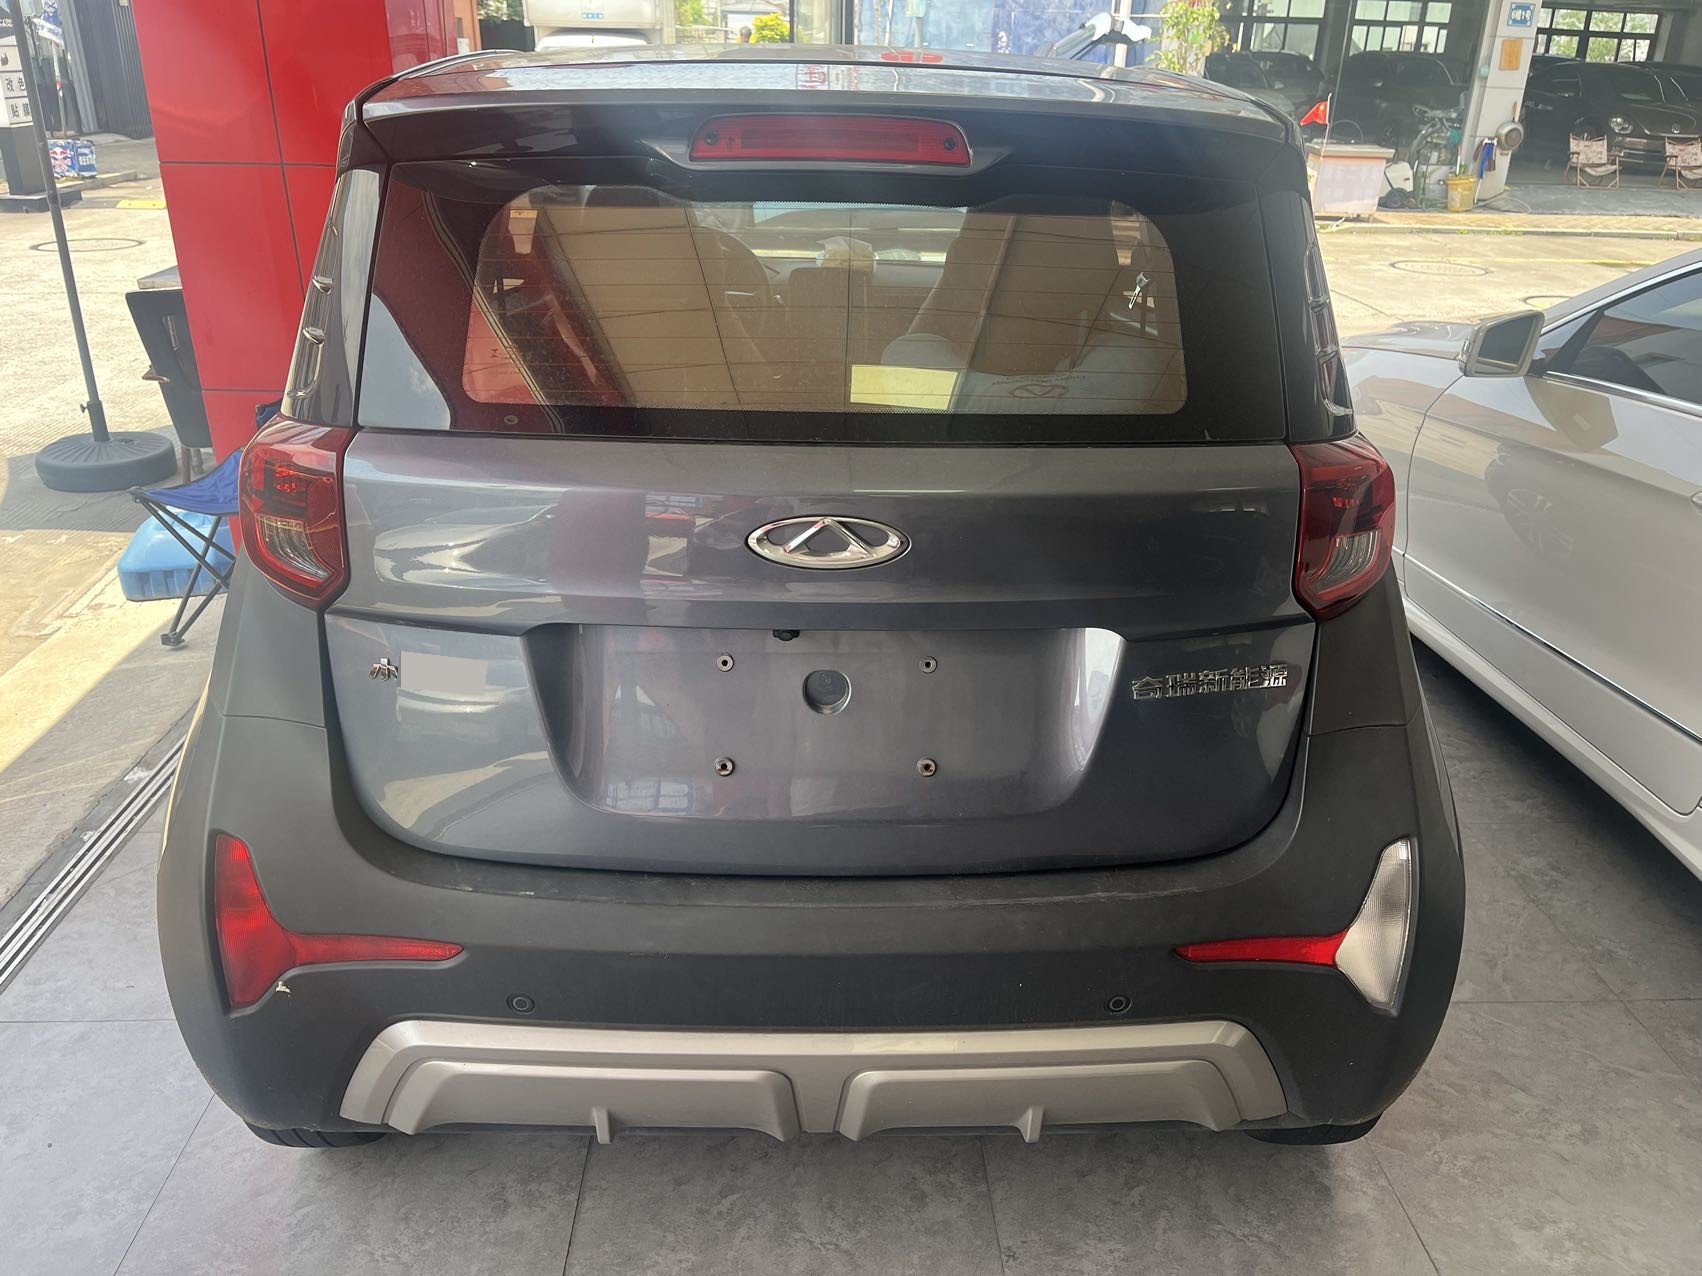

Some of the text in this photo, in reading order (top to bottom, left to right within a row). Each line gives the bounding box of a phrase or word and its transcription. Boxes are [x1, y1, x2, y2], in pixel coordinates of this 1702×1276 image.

[5, 76, 26, 92] 改色
[1132, 664, 1288, 700] 奇瑞新能源
